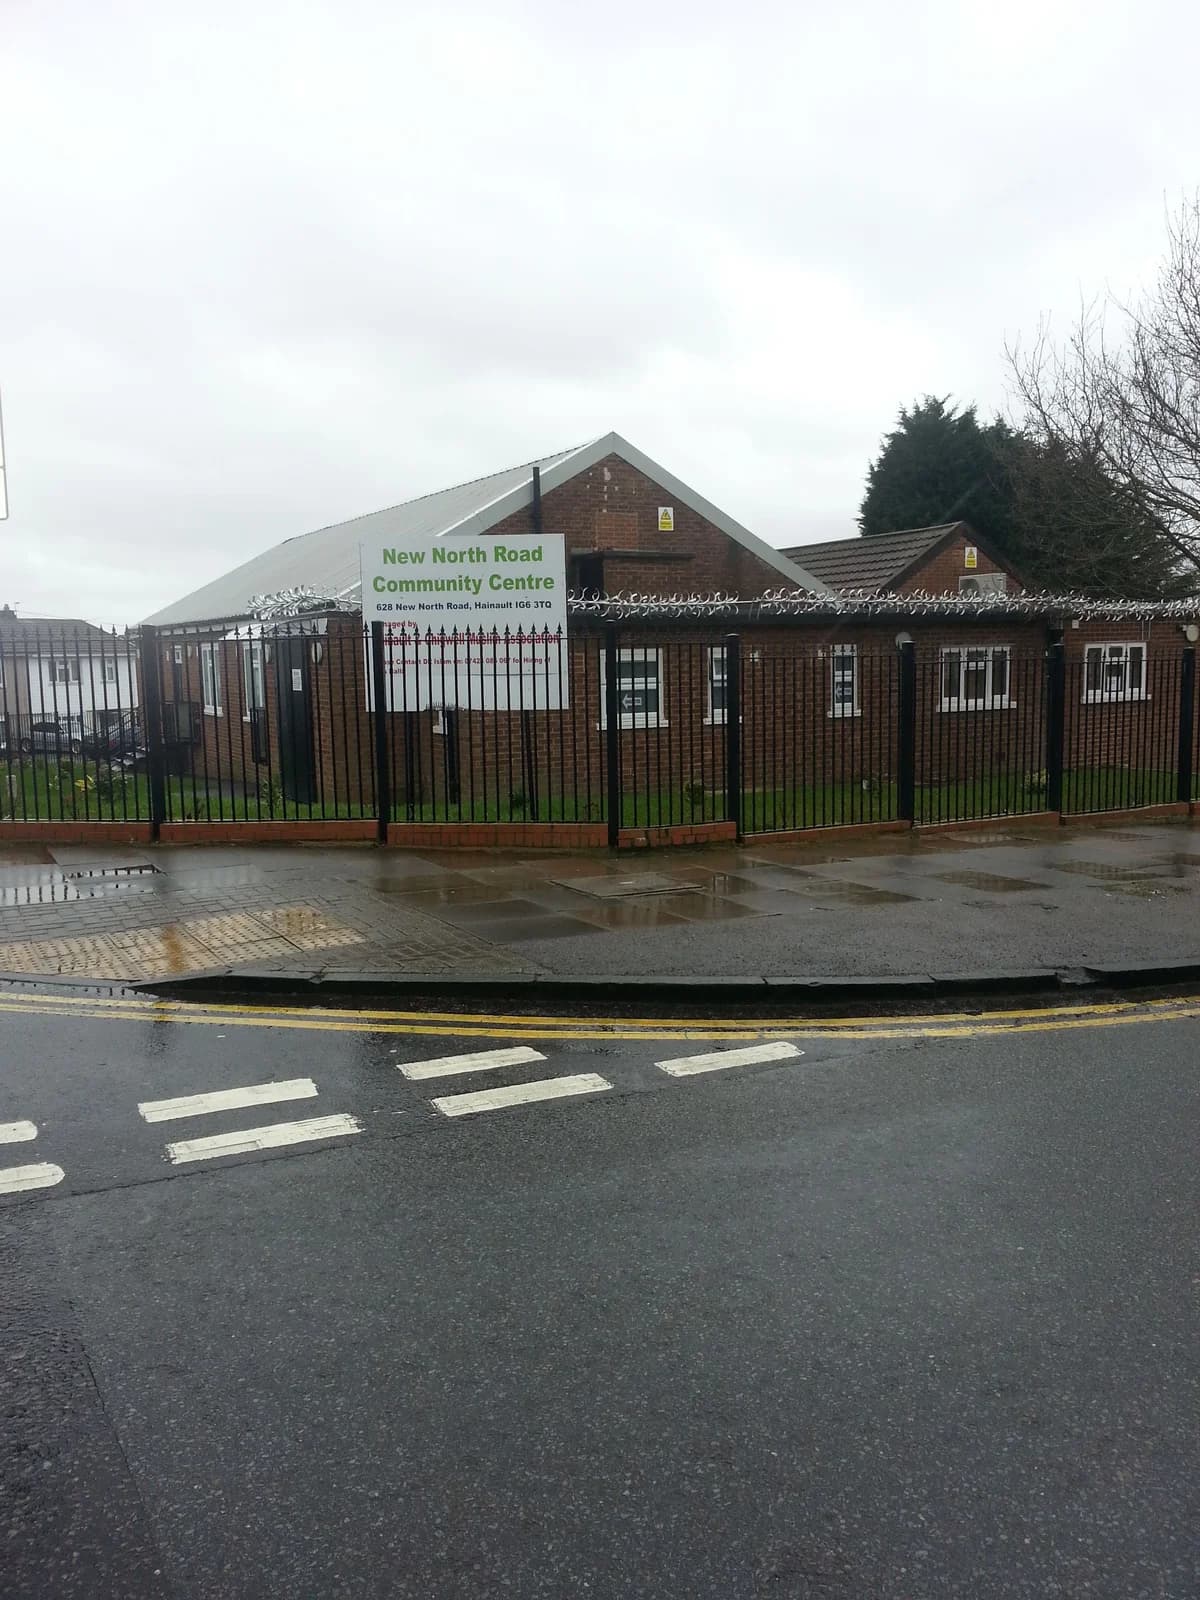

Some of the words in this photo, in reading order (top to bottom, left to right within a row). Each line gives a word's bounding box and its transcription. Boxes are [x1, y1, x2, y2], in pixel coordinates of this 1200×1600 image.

[383, 548, 425, 564] New
[432, 547, 486, 563] North
[494, 545, 543, 562] Road
[372, 575, 482, 594] Community
[489, 574, 554, 591] Centre
[396, 603, 416, 611] New
[418, 602, 444, 610] North
[446, 602, 472, 611] Road,
[475, 601, 512, 609] Hainault
[515, 601, 531, 609] IG6
[533, 600, 552, 609] 3TQ
[504, 632, 561, 645] Assocaton
